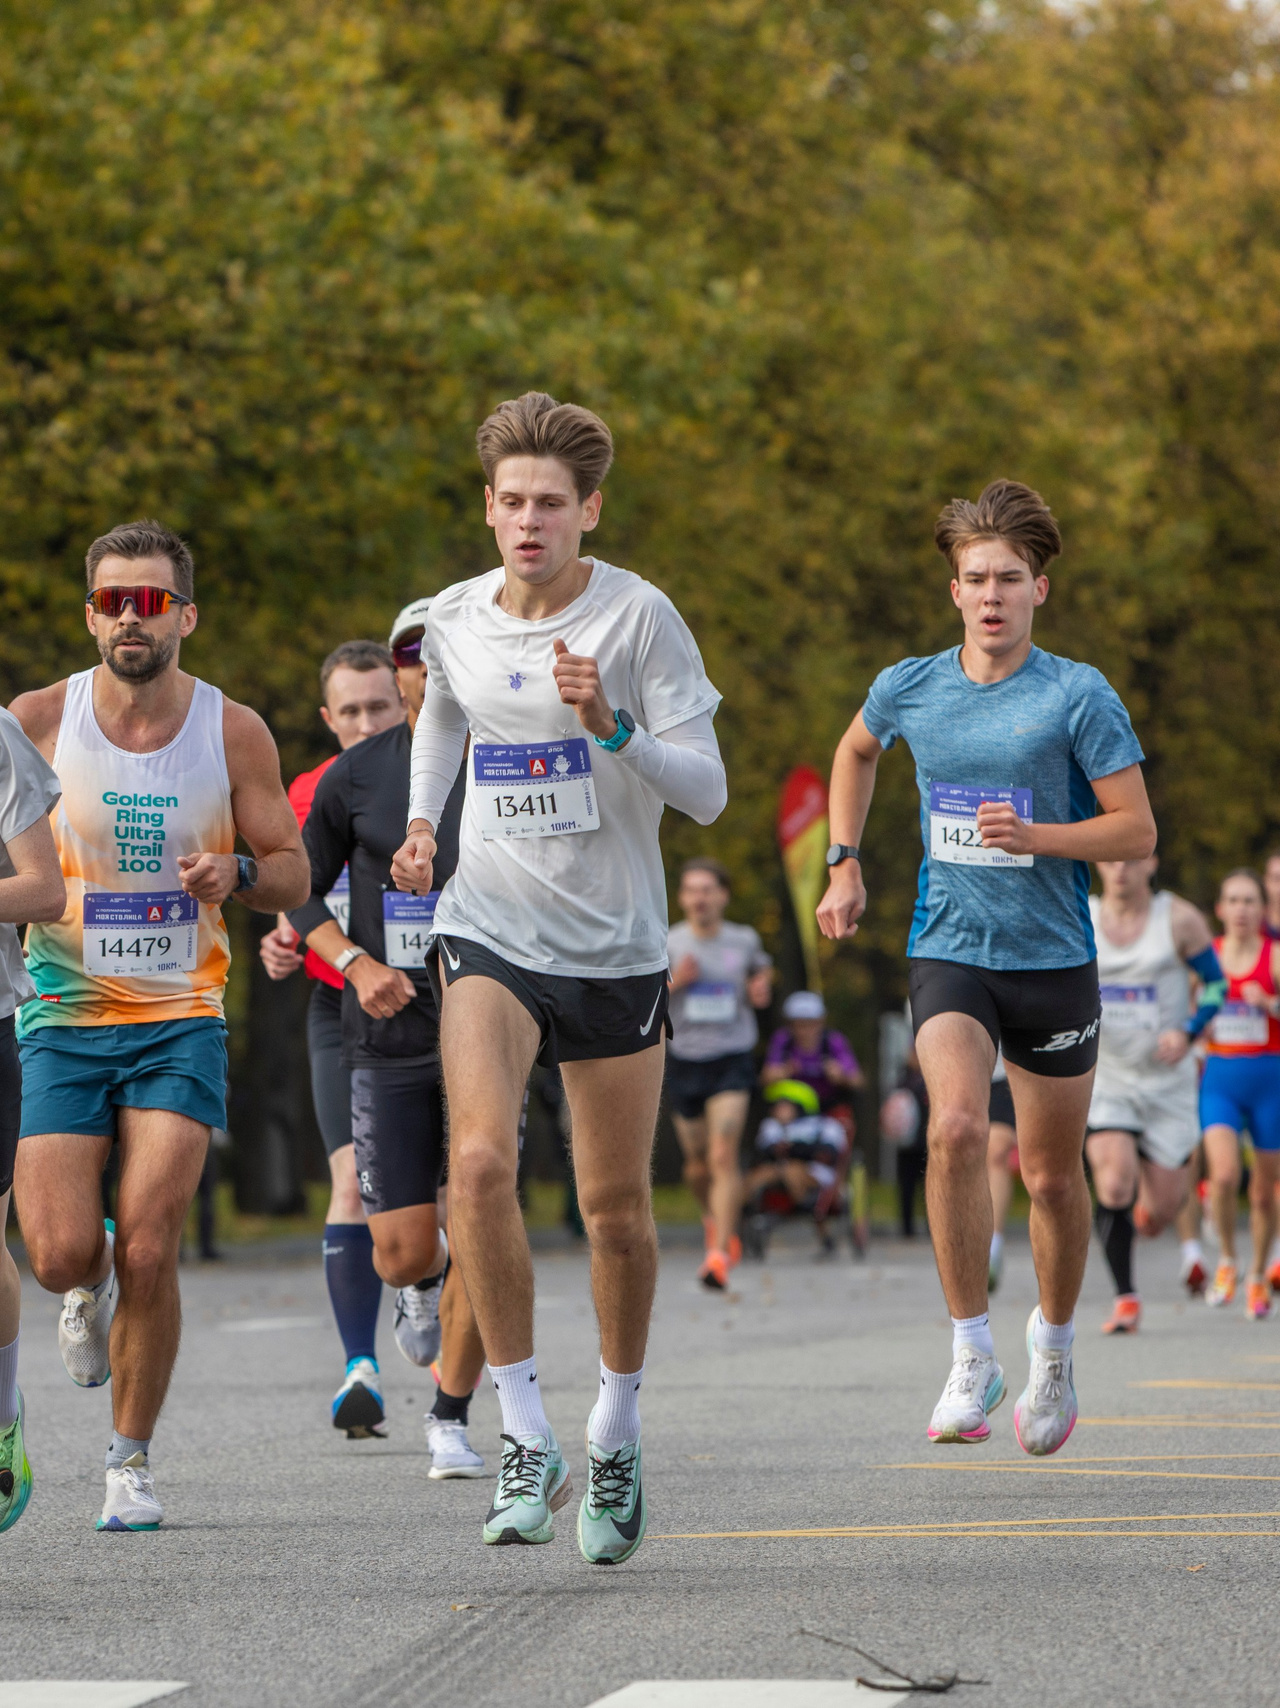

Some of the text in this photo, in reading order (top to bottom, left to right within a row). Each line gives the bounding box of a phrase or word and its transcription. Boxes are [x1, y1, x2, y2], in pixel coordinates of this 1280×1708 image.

[102, 791, 178, 808] Golden
[493, 792, 557, 817] 13411
[116, 808, 164, 827] Ring
[114, 826, 166, 841] Ultra
[941, 826, 983, 848] 1422
[116, 842, 163, 857] Trail
[118, 859, 162, 873] 100
[98, 936, 172, 957] 14479
